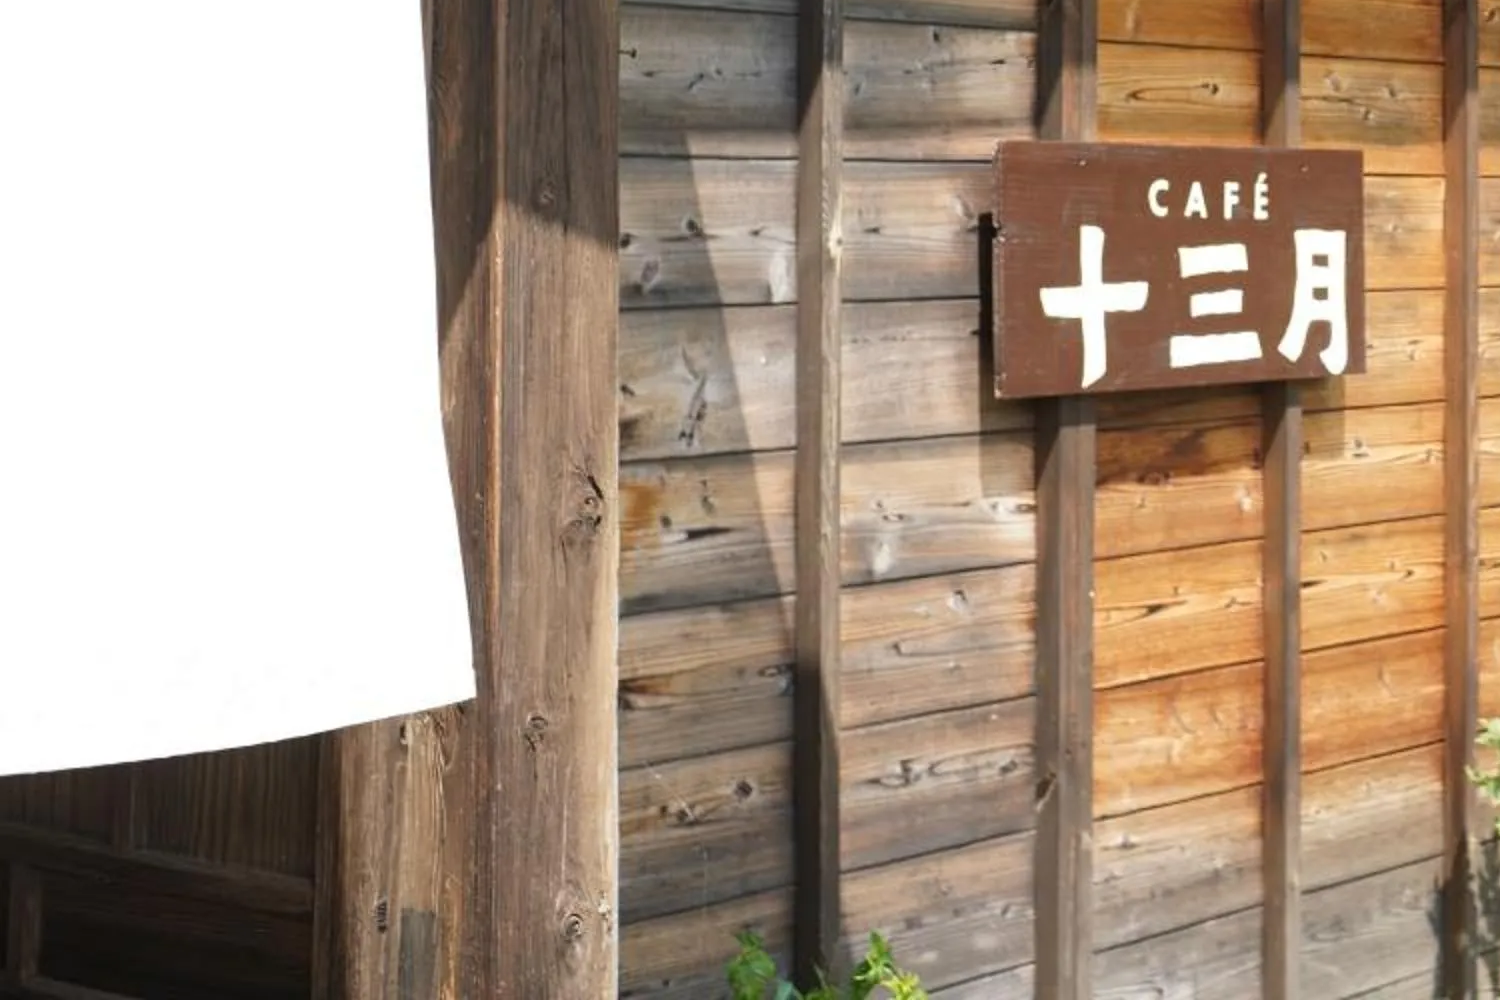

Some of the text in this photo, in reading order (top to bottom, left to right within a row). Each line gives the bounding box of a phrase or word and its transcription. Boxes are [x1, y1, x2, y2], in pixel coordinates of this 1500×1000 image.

[1147, 171, 1270, 220] CAFÉ
[1038, 224, 1350, 389] 十三月
